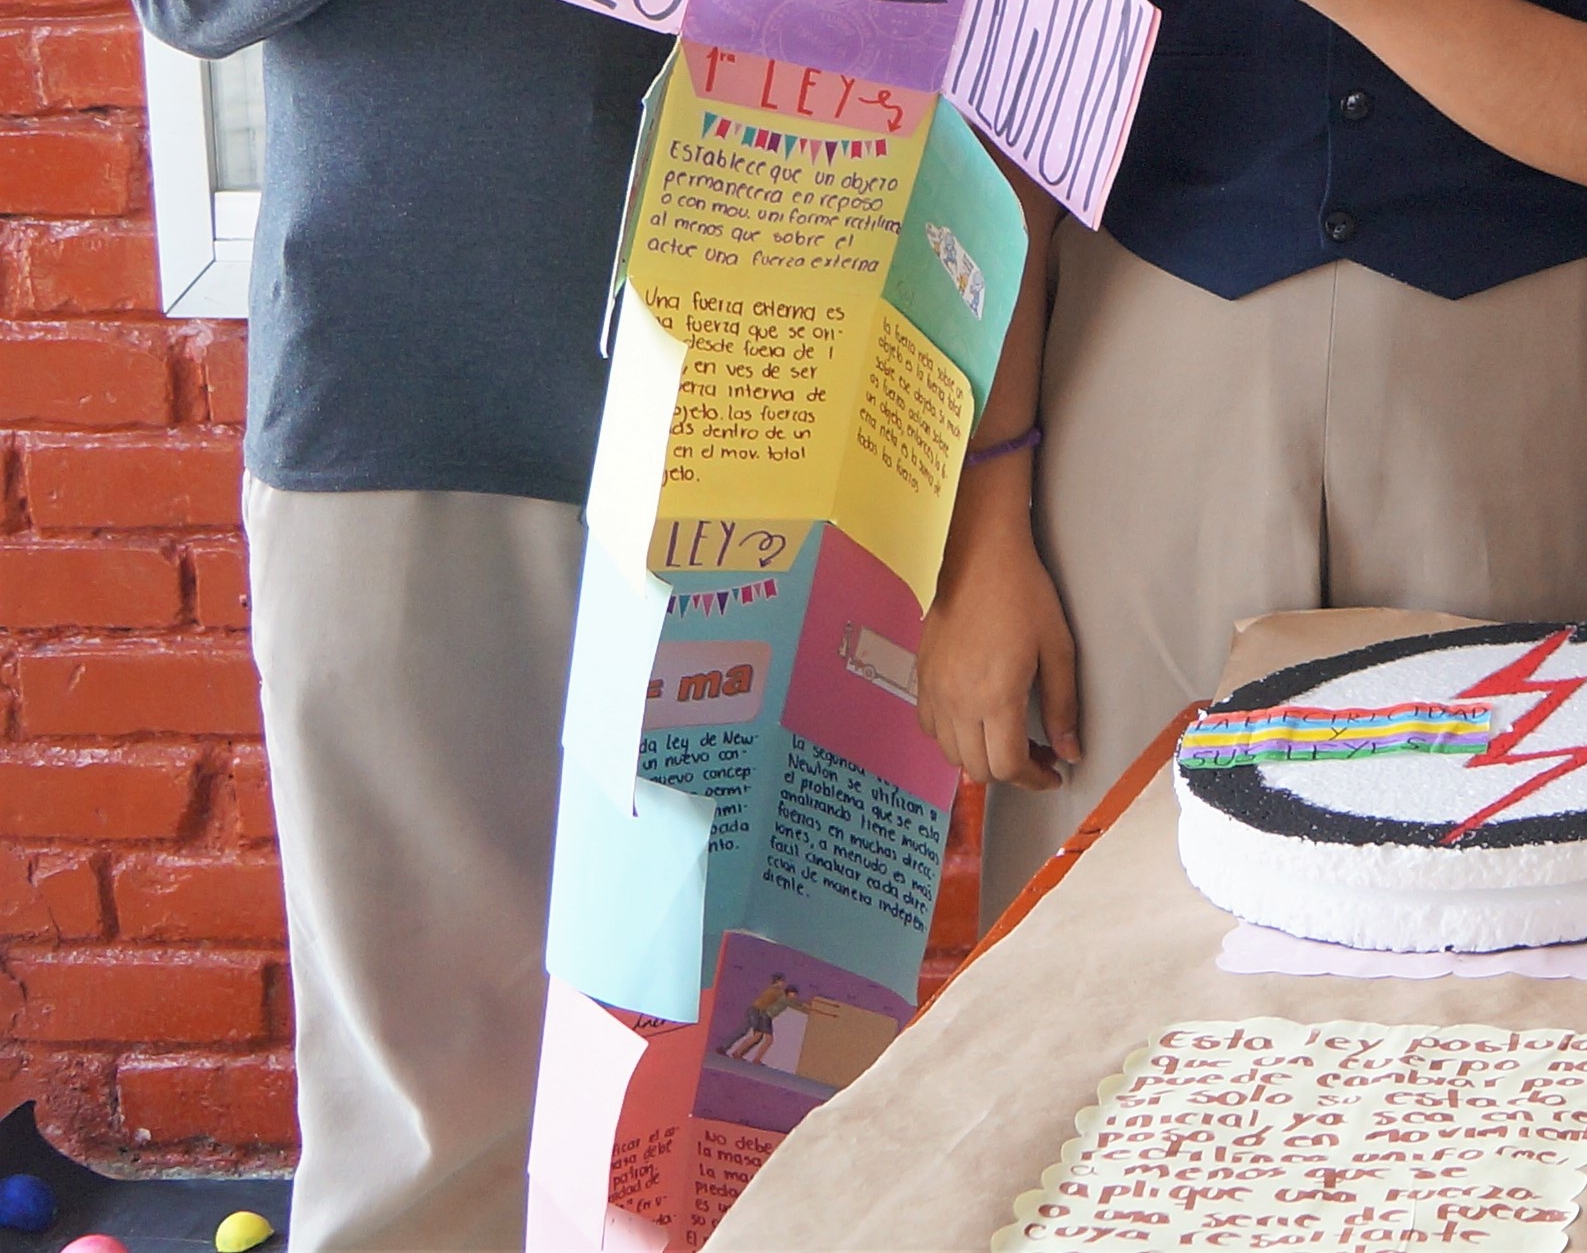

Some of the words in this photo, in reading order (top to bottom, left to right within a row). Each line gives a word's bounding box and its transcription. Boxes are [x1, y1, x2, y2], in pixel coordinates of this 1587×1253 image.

[760, 58, 856, 119] LEY
[815, 171, 836, 187] un
[704, 248, 739, 266] una
[644, 286, 681, 311] Una
[793, 341, 815, 360] de
[761, 360, 781, 379] de
[790, 365, 818, 380] ser
[806, 386, 827, 403] de
[765, 424, 785, 440] de
[665, 520, 736, 568] LEY
[676, 663, 755, 703] ma
[1159, 1028, 1276, 1051] Esta
